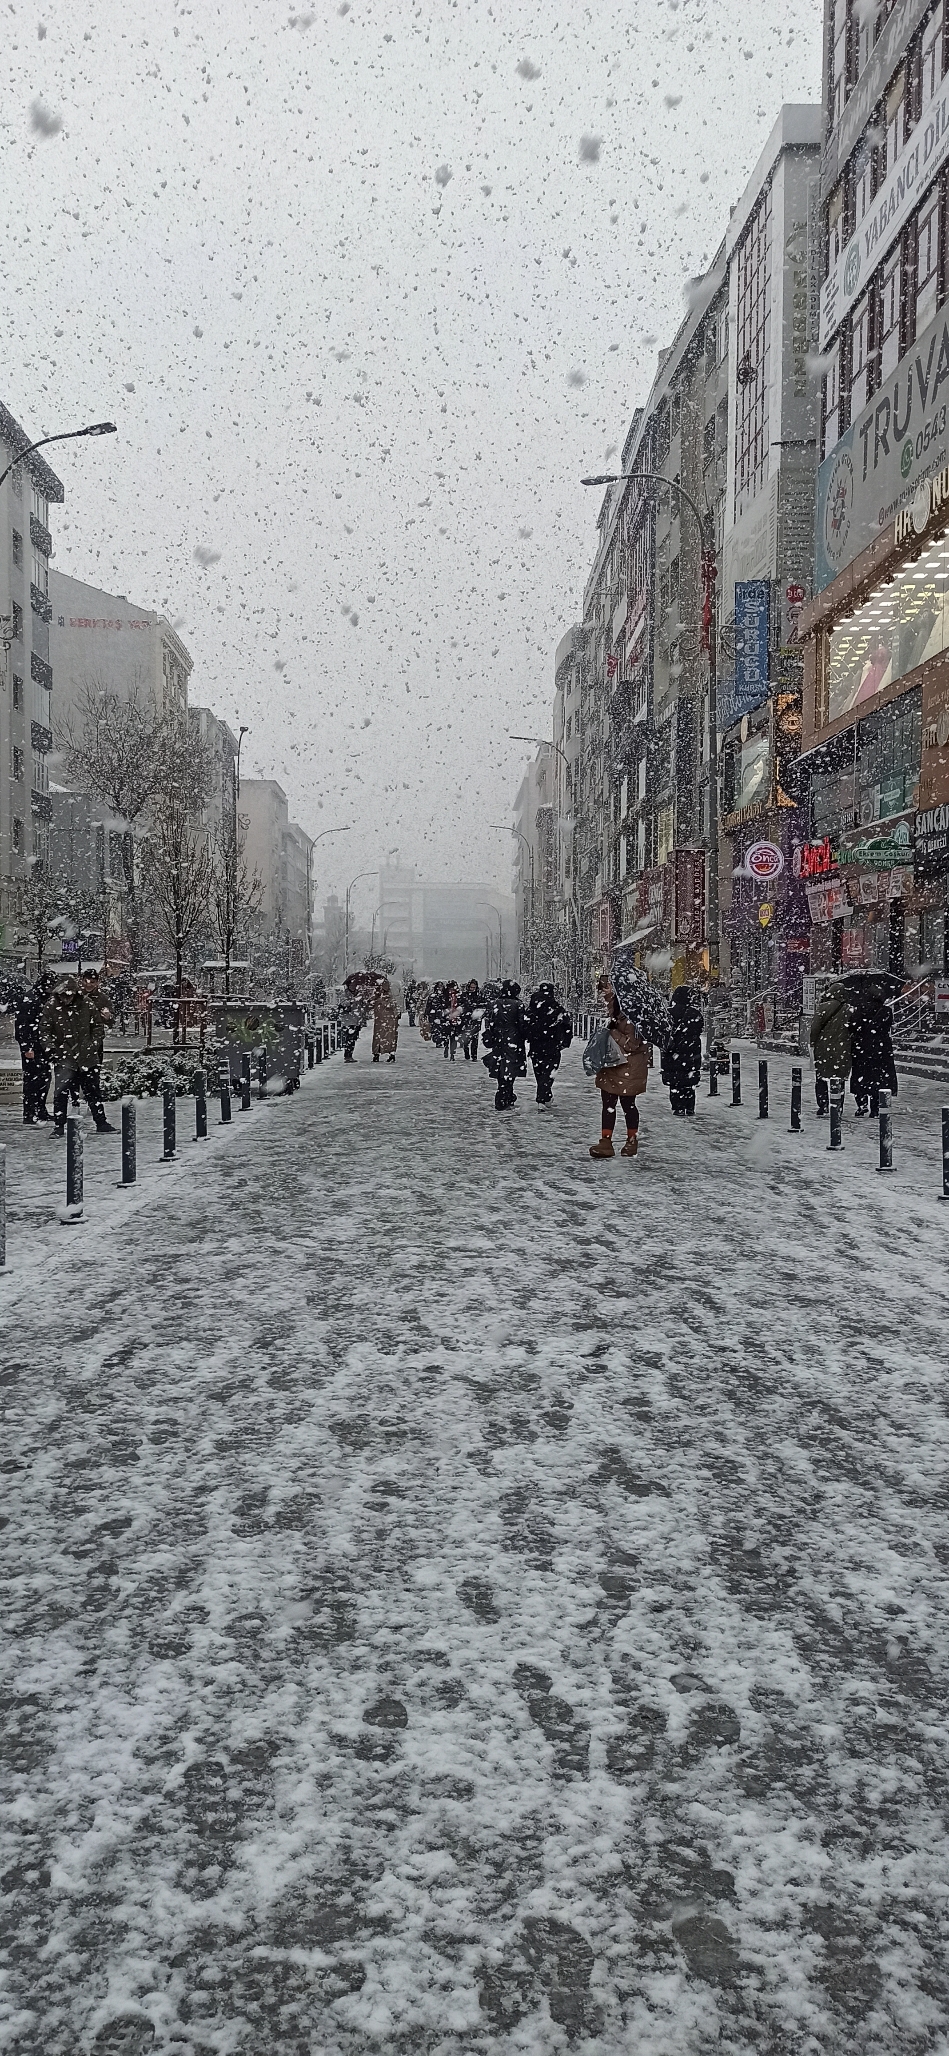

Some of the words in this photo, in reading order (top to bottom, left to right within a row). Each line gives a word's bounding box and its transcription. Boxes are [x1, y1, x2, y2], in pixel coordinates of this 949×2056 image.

[864, 143, 920, 259] YABANCI
[923, 97, 949, 165] DİL
[859, 321, 949, 483] TRUVA
[915, 404, 947, 461] 0543
